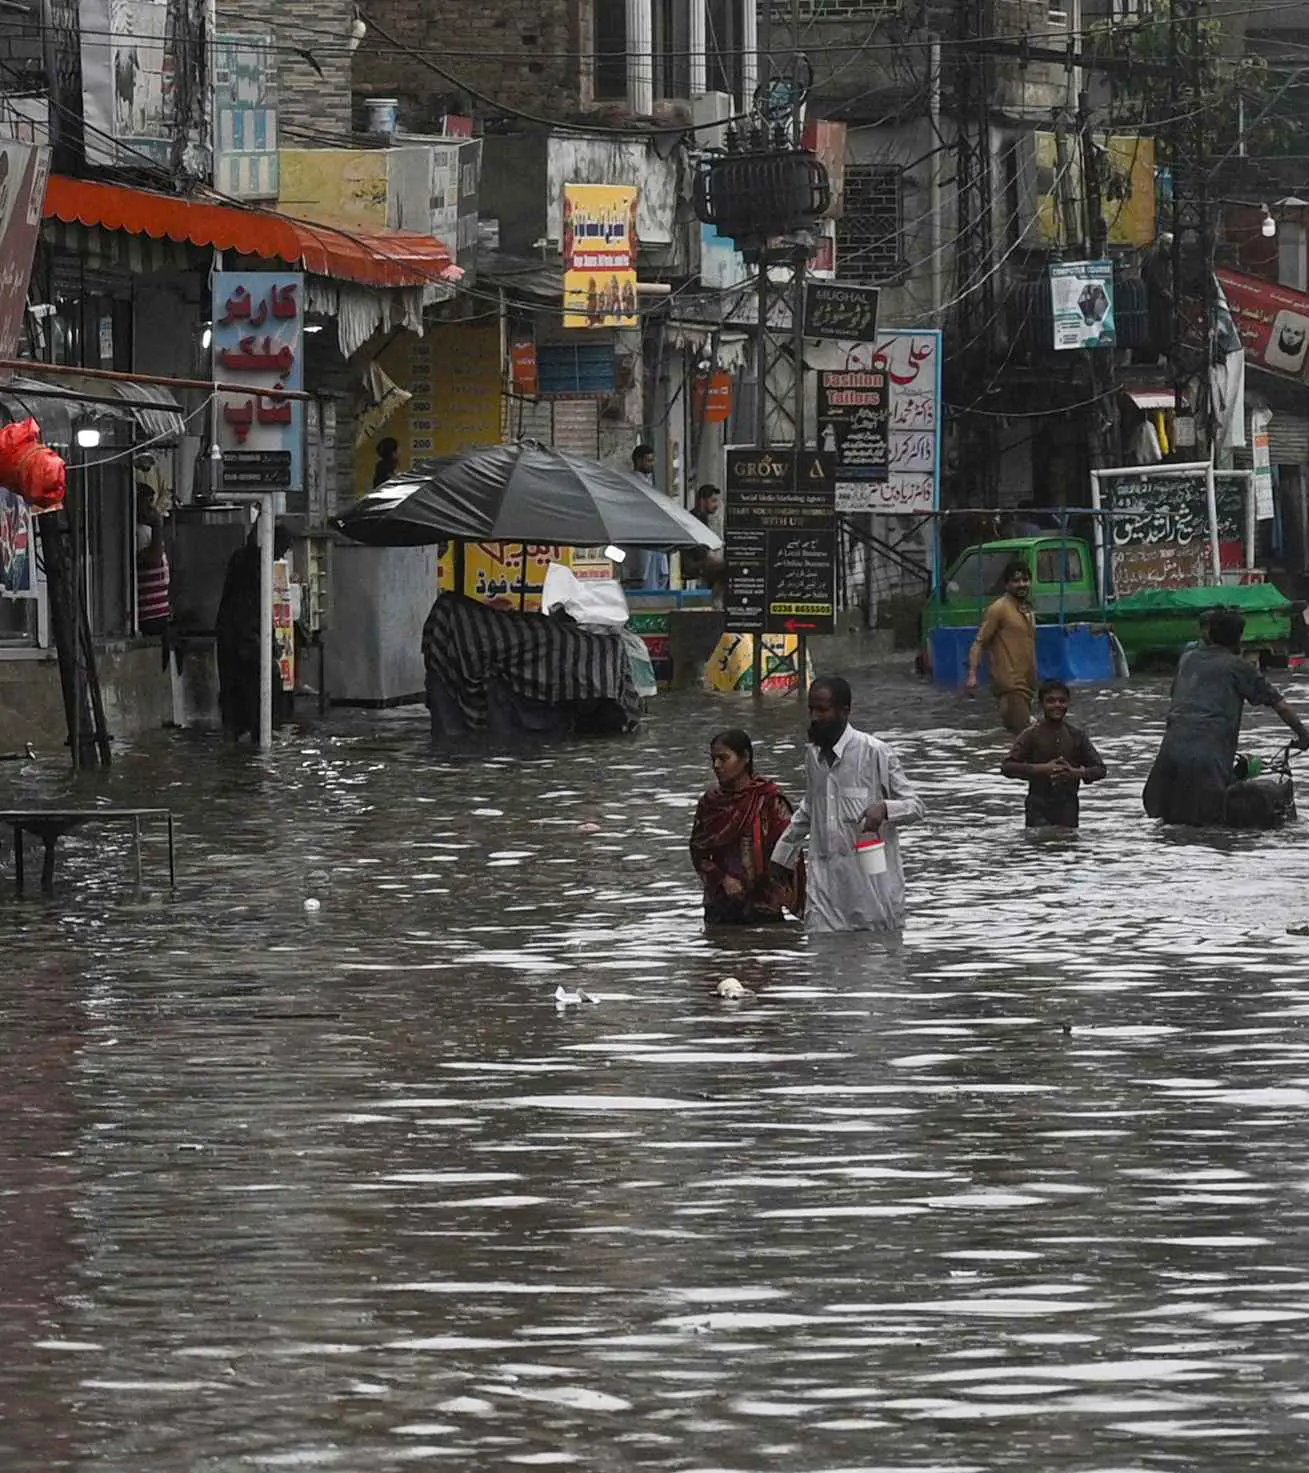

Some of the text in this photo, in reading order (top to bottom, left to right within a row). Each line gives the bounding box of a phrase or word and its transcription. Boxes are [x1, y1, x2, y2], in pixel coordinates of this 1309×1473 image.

[218, 283, 297, 327] کارنر
[221, 336, 293, 379] ملک
[822, 372, 884, 388] Fashion
[826, 389, 881, 405] Tailors
[223, 382, 292, 444] شاپ
[734, 462, 788, 477] GROW
